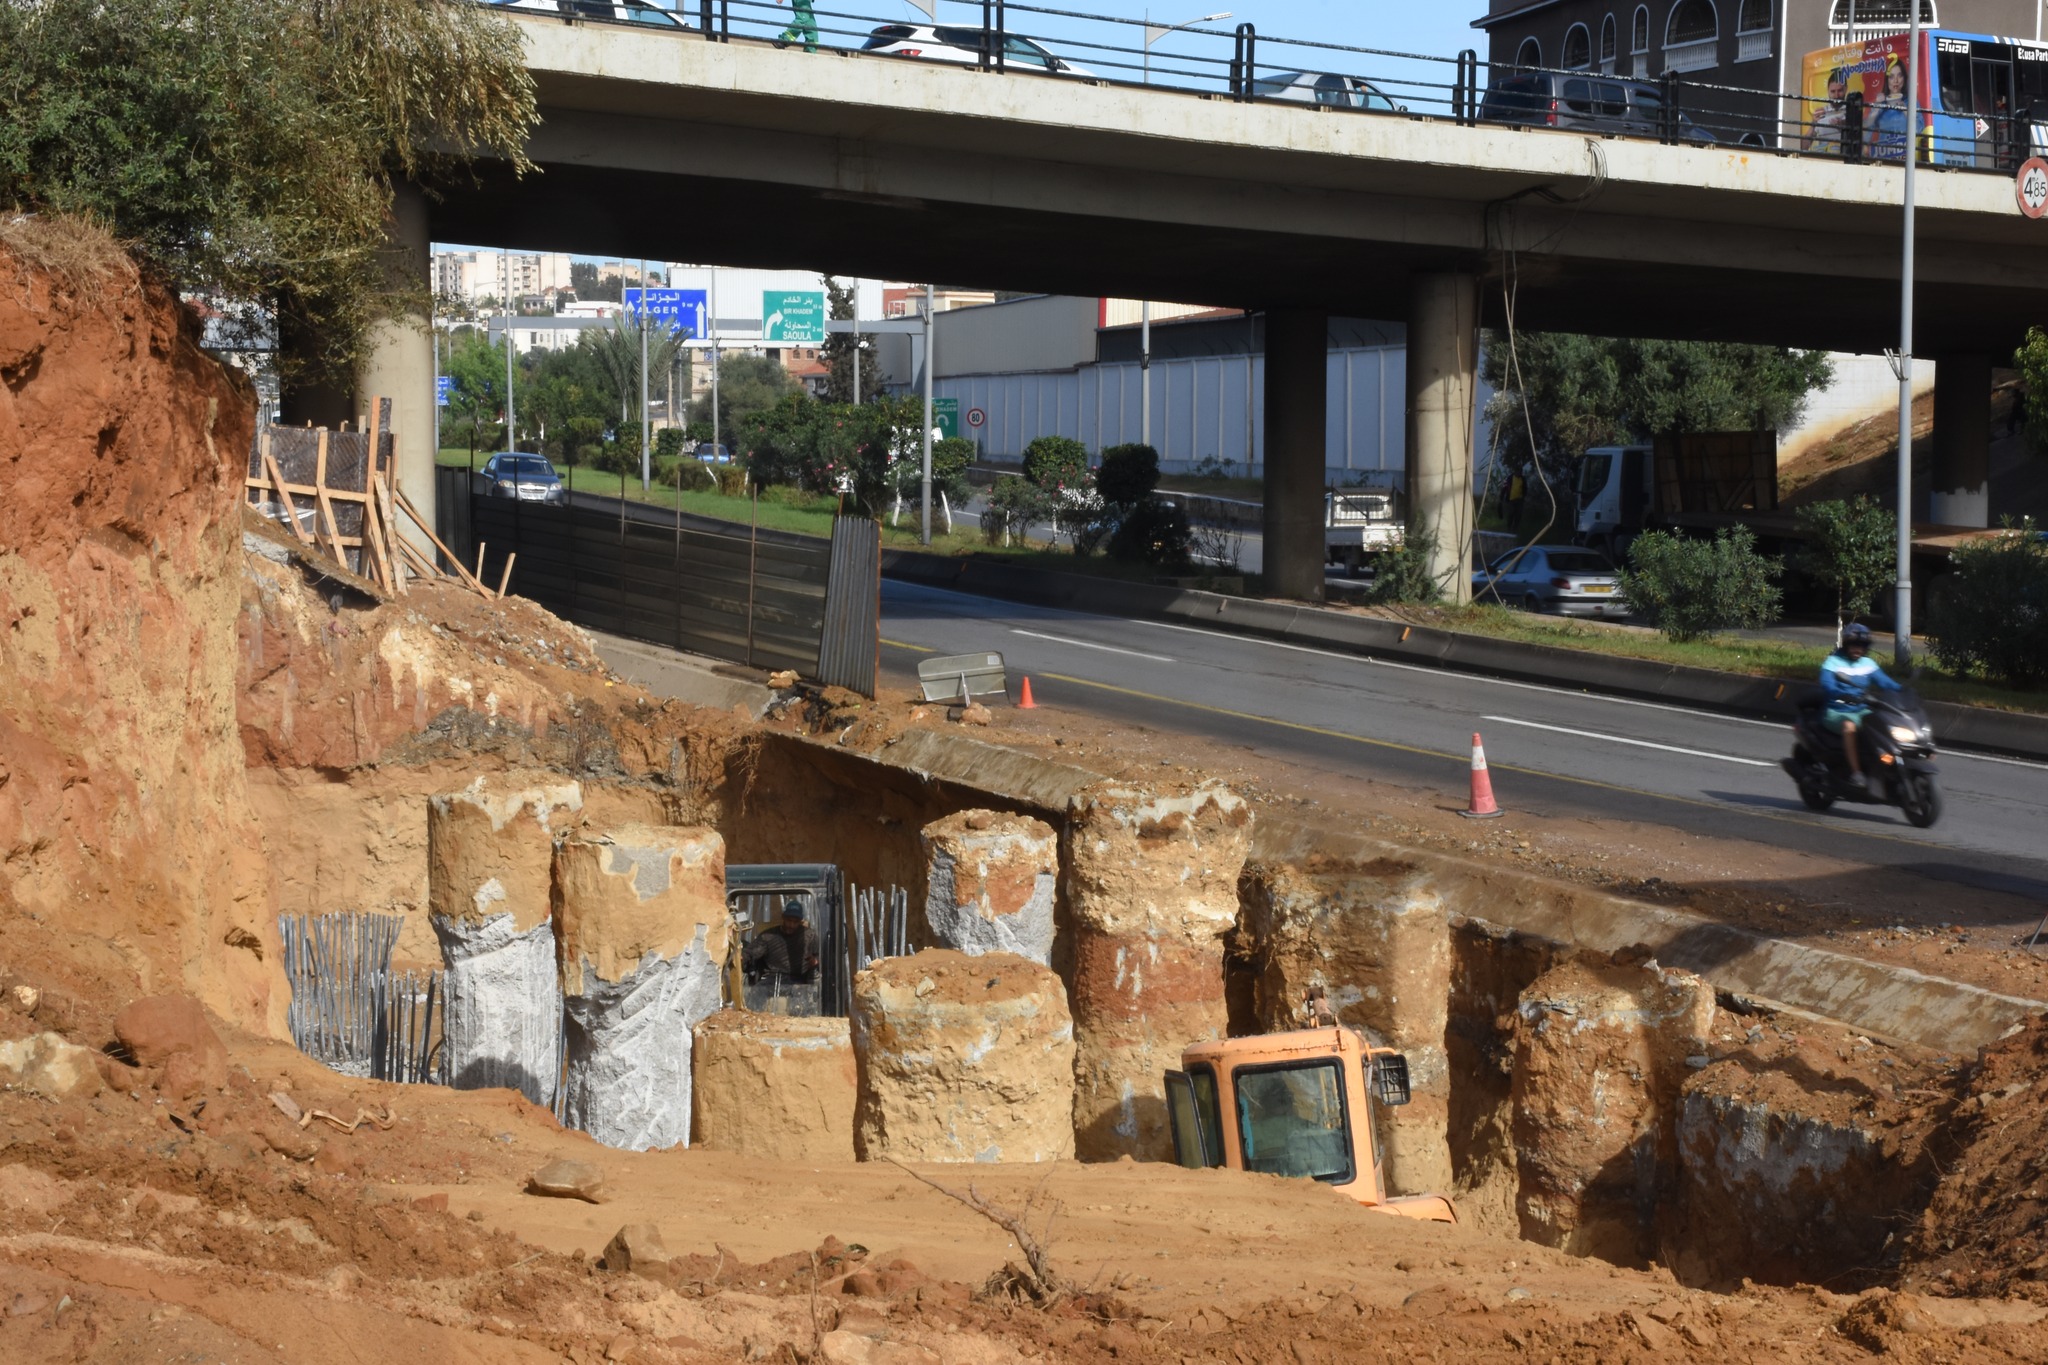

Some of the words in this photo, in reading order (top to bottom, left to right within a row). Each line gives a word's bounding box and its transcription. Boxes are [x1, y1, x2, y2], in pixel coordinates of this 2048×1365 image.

[637, 306, 679, 314] ALGER
[782, 331, 812, 341] SAOULA
[971, 413, 980, 422] 80
